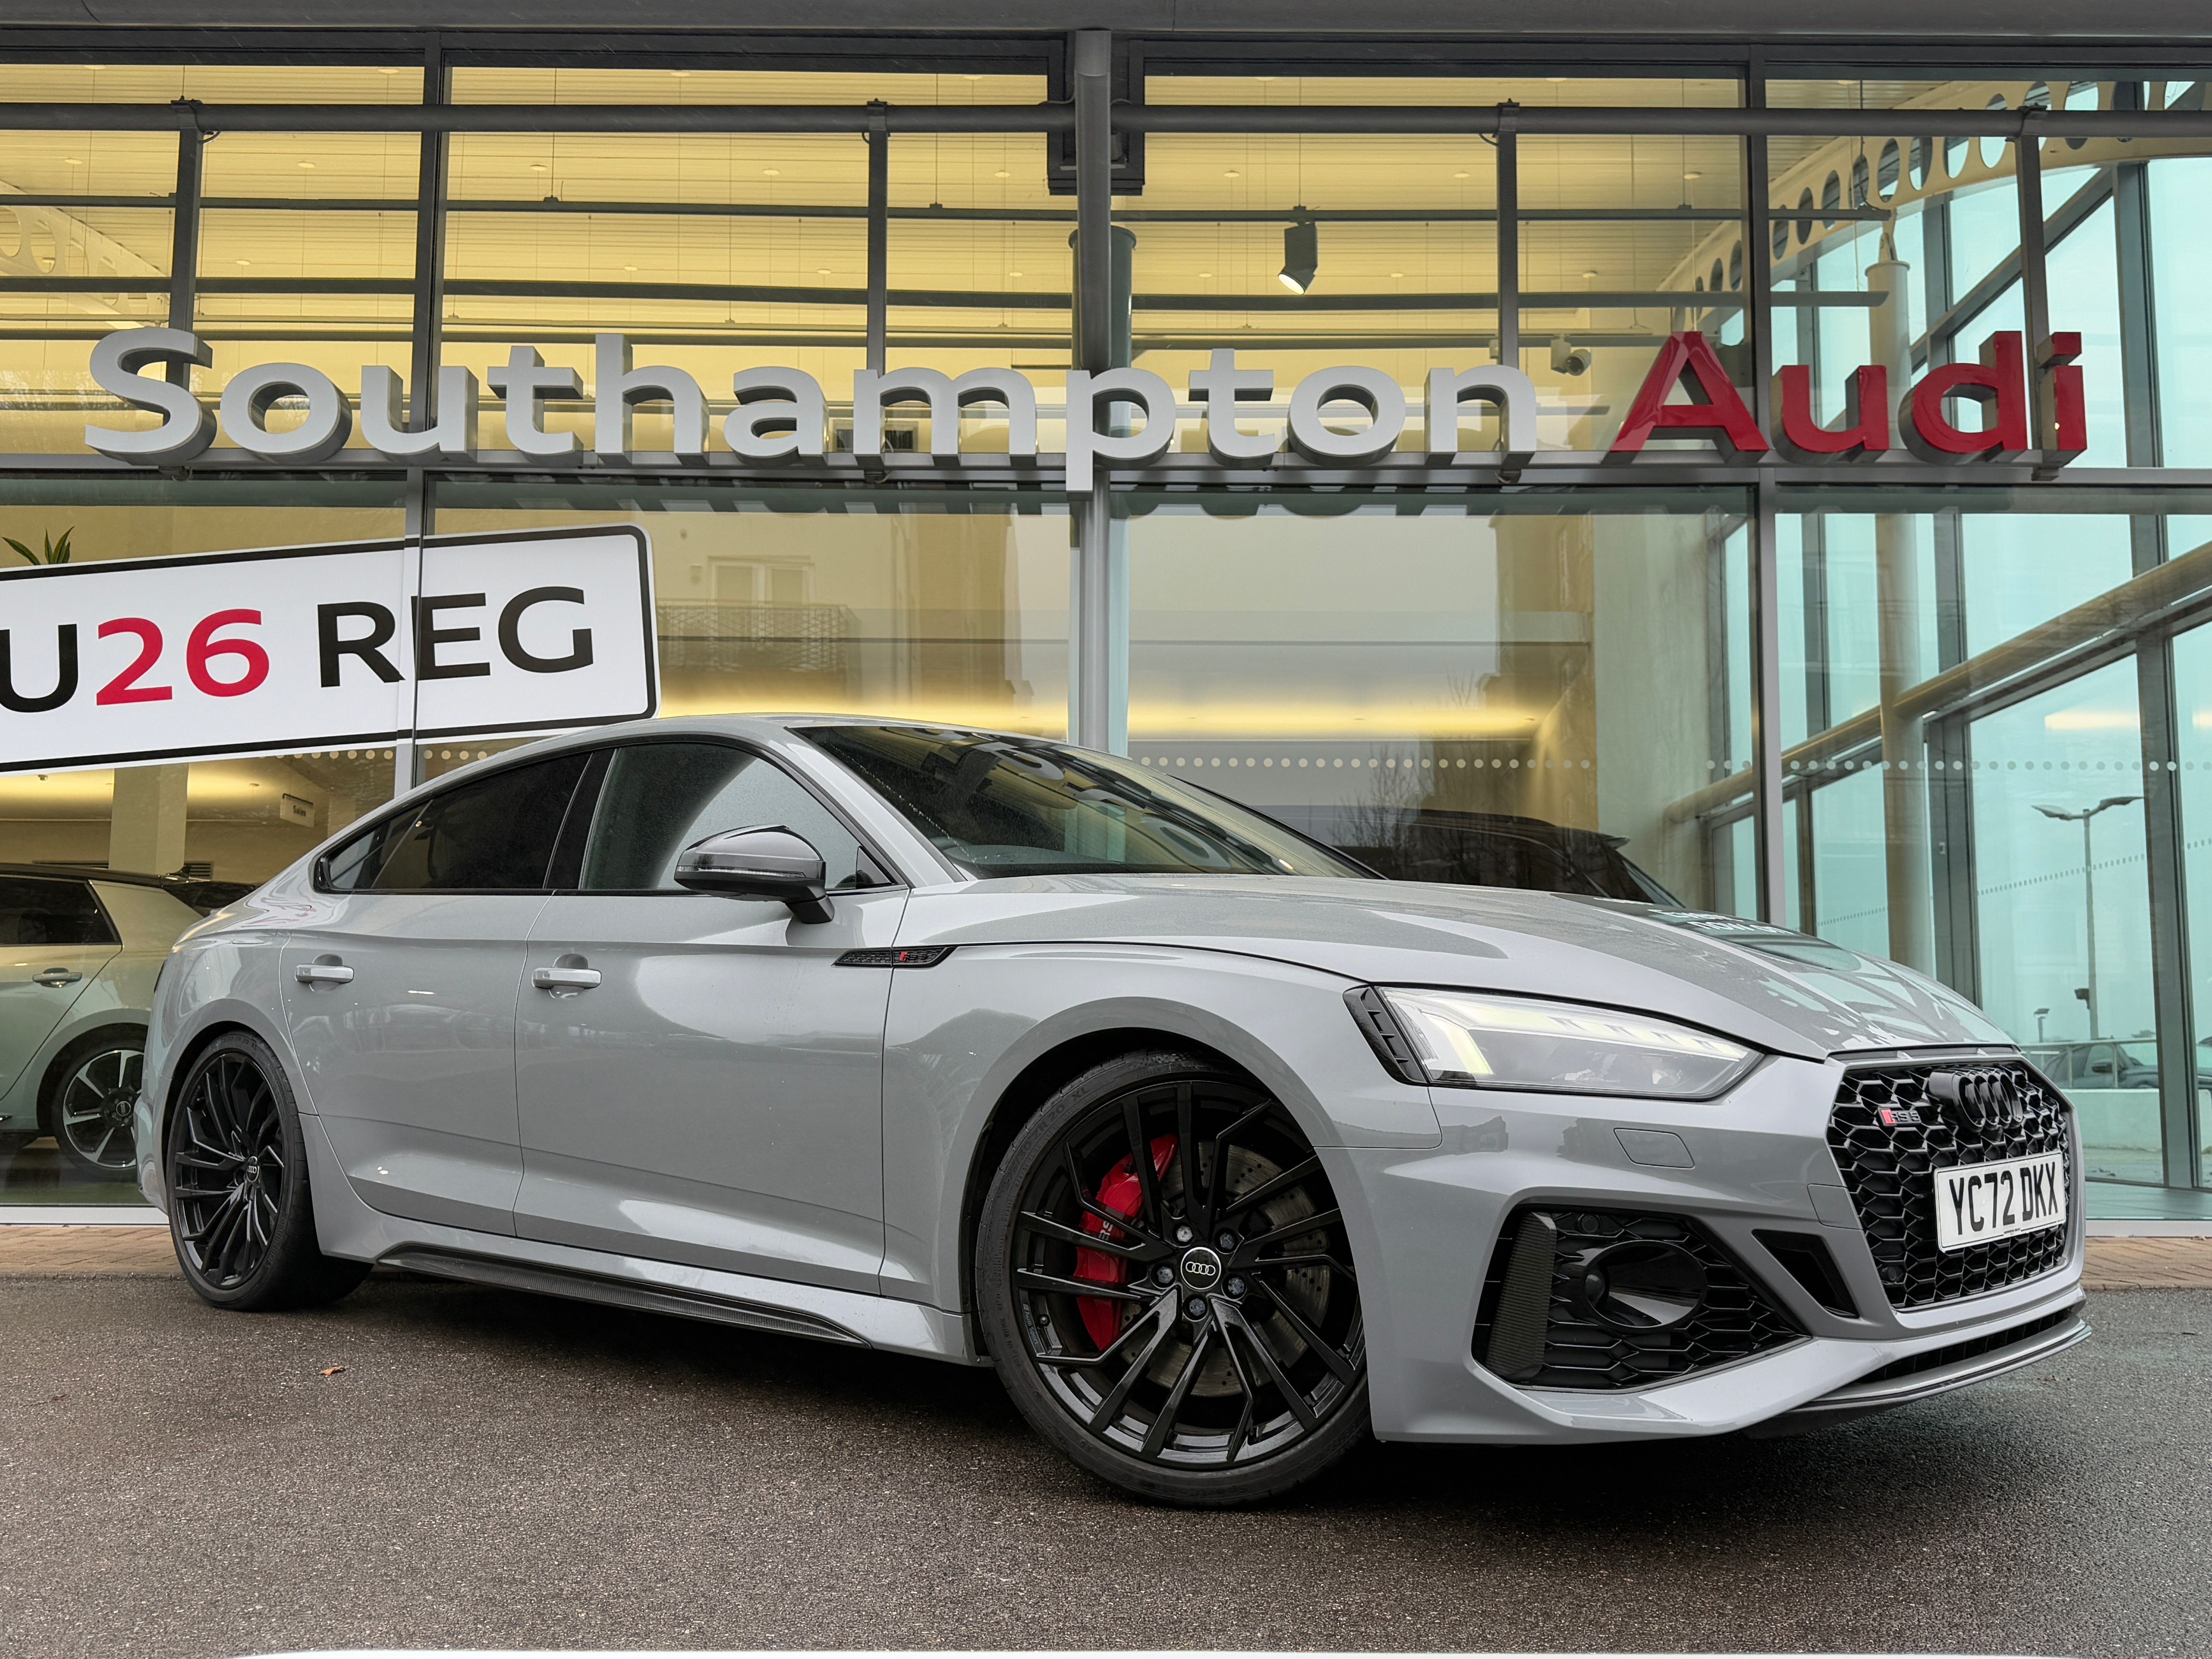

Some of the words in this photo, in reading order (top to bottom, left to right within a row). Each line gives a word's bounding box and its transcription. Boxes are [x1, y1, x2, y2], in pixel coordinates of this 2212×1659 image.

[85, 326, 1538, 494] Southampton
[1603, 331, 2087, 461] Audi
[318, 586, 594, 688] REG
[1949, 1170, 2015, 1235] YC72
[2020, 1161, 2059, 1221] DKX
[1029, 1326, 1039, 1345] Sport
